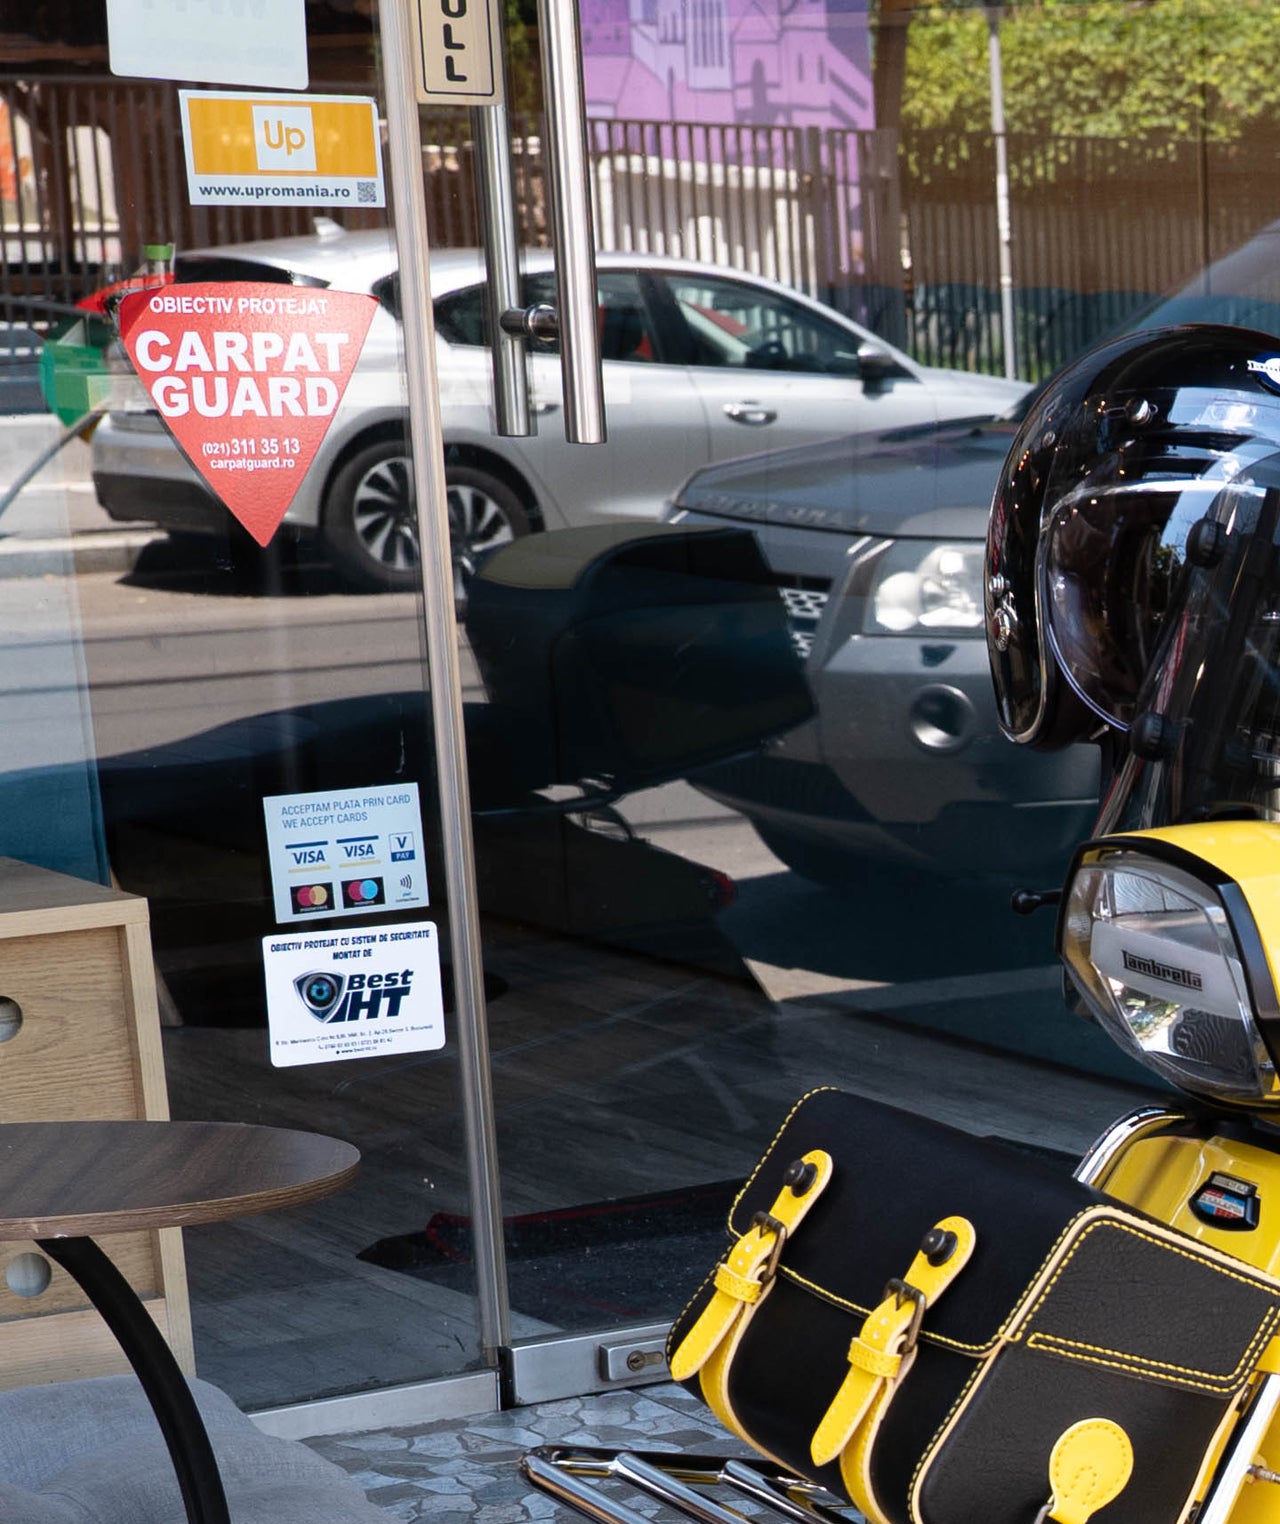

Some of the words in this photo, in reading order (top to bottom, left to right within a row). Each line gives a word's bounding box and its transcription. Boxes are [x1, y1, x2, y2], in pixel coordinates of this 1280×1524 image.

[264, 119, 306, 156] Up
[199, 184, 351, 199] www.upromania.ro
[149, 294, 236, 316] OBIECTIV
[237, 296, 329, 317] PROTEJAT
[134, 328, 350, 374] CARPAT
[151, 377, 339, 419] GUARD
[202, 442, 231, 457] (021)
[231, 438, 256, 455] 311
[261, 438, 279, 455] 35
[283, 438, 300, 454] 13
[210, 457, 295, 472] carpatguard.ro
[281, 802, 331, 816] ACCEPTAM
[333, 799, 361, 811] PLATA
[363, 797, 384, 808] PRIN
[386, 794, 411, 806] CARD
[282, 819, 298, 829] WE
[300, 814, 334, 827] ACCEPT
[337, 811, 368, 824] CARDS
[342, 843, 375, 858] VISA
[396, 836, 407, 849] V
[291, 849, 326, 865] VISA
[271, 941, 303, 952] OBIECTIV
[304, 938, 338, 949] PROTEJAT
[340, 936, 350, 946] CU
[351, 933, 377, 945] SISTEM
[379, 932, 388, 942] DE
[390, 929, 430, 942] SECURITATE
[332, 949, 361, 960] MONTAT
[363, 948, 372, 957] DE
[347, 968, 414, 991] Best
